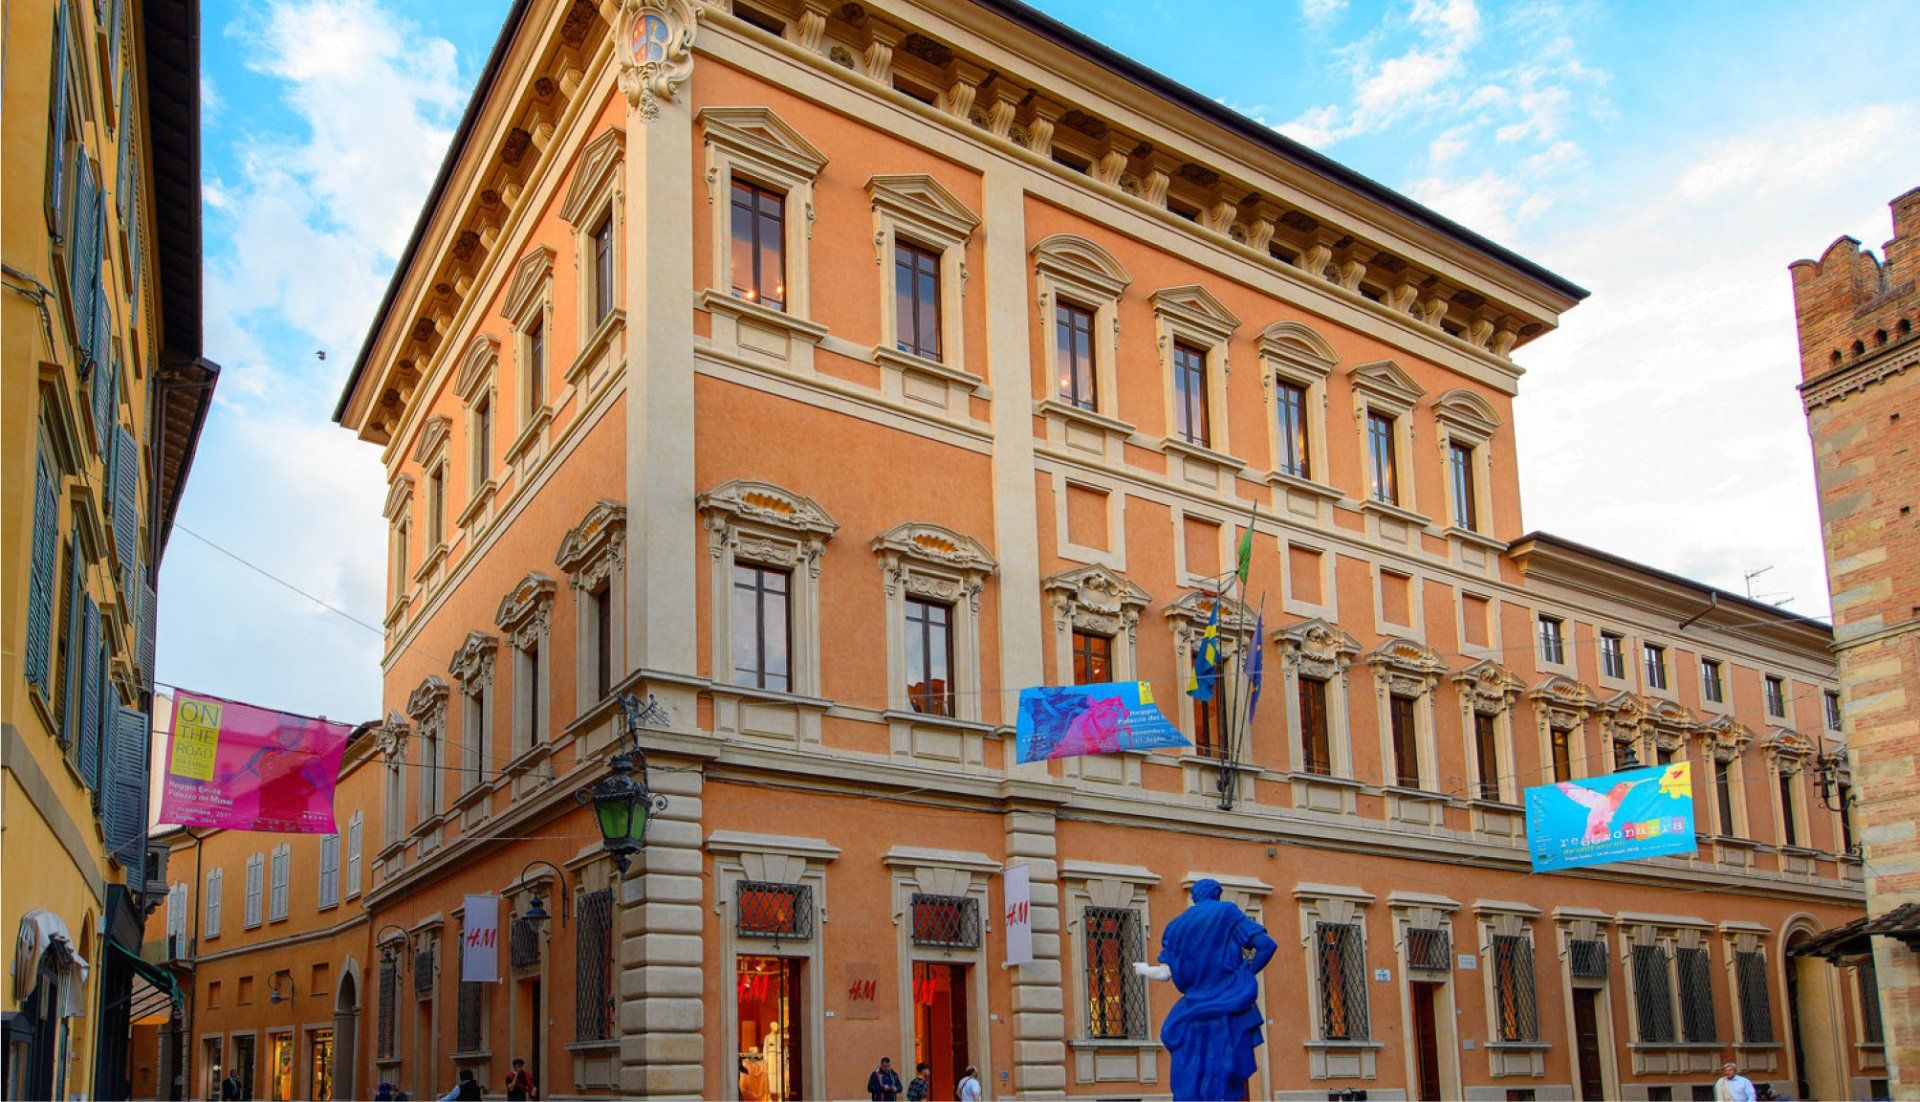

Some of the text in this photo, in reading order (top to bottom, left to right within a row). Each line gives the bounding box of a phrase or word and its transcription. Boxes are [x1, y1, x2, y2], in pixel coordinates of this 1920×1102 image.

[181, 701, 219, 727] ON
[181, 725, 217, 745] THE
[176, 743, 213, 760] ROAD
[169, 780, 197, 792] Reggio
[168, 788, 197, 801] Palazzo
[210, 795, 233, 805] Musei
[1560, 821, 1684, 848] reggionarra
